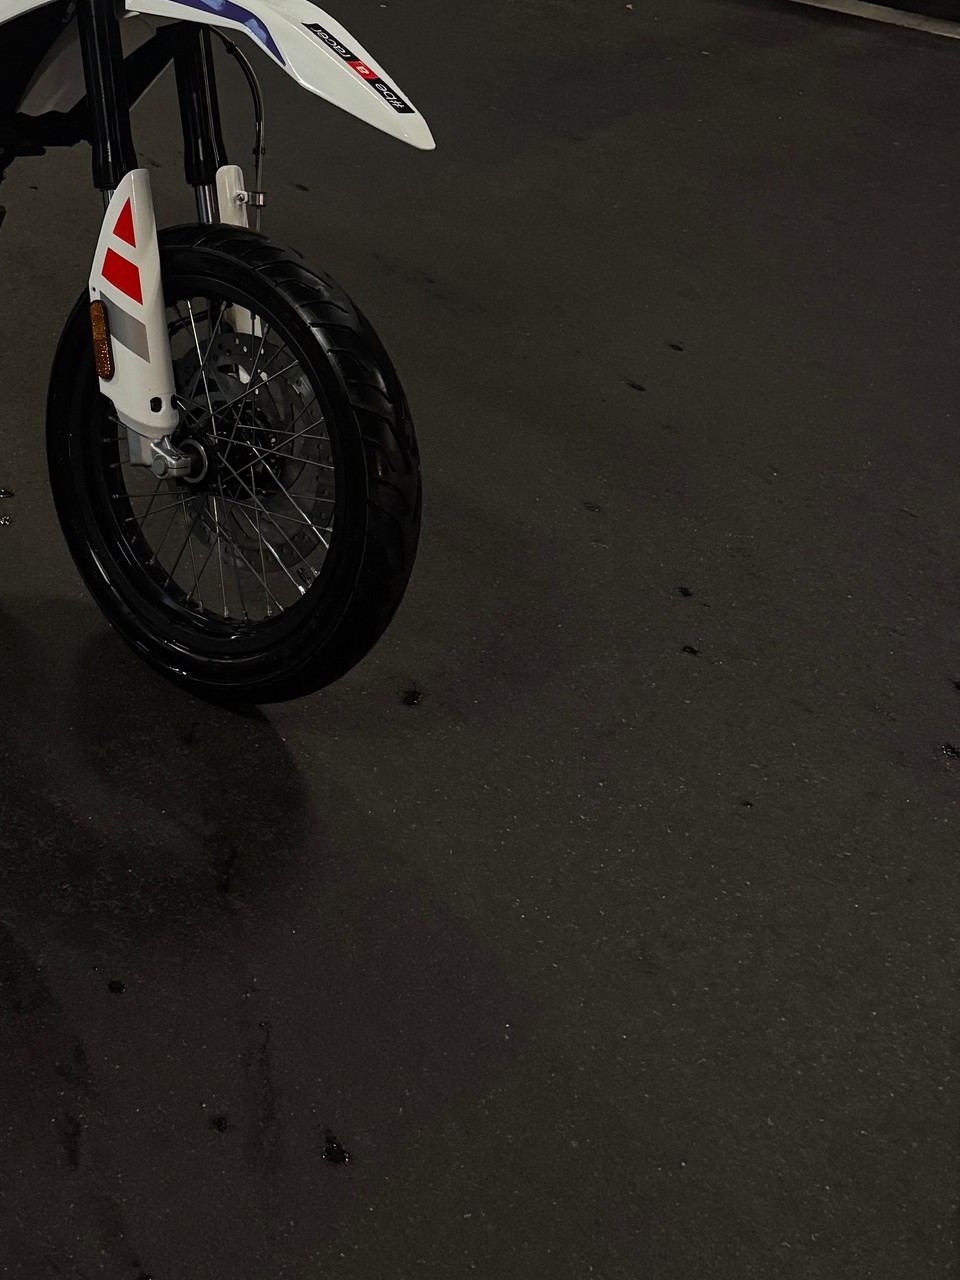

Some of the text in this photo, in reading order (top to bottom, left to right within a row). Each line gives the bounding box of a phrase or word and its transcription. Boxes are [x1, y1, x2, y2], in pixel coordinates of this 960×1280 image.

[311, 28, 405, 109] #be a racer
